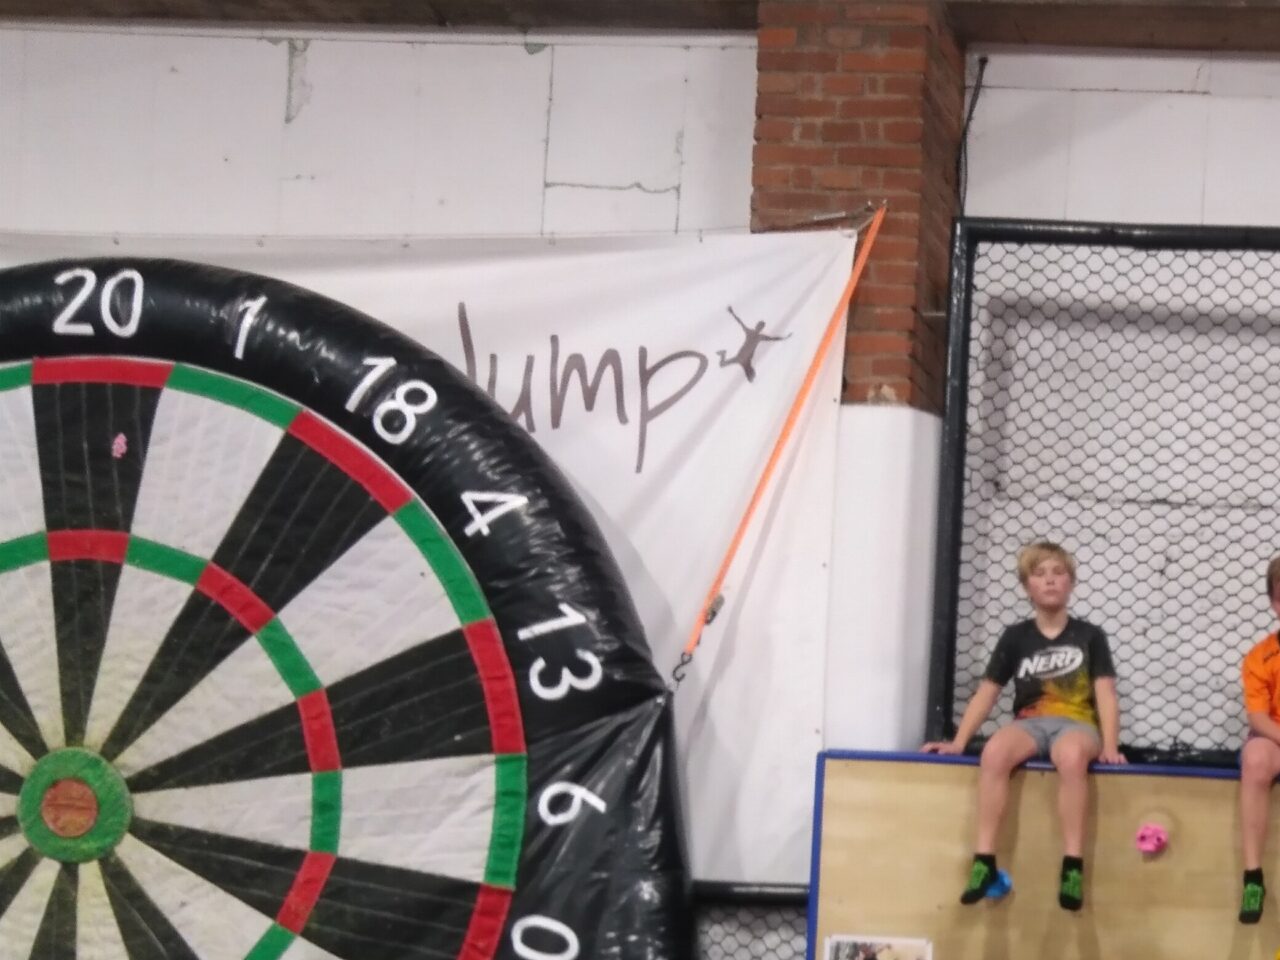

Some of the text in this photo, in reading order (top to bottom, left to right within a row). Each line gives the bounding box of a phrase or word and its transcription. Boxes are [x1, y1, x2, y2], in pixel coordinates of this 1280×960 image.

[53, 268, 144, 337] 20
[233, 295, 269, 359] 1
[345, 356, 438, 445] 18
[460, 490, 534, 537] 4
[517, 602, 603, 700] 13
[537, 781, 607, 826] 6
